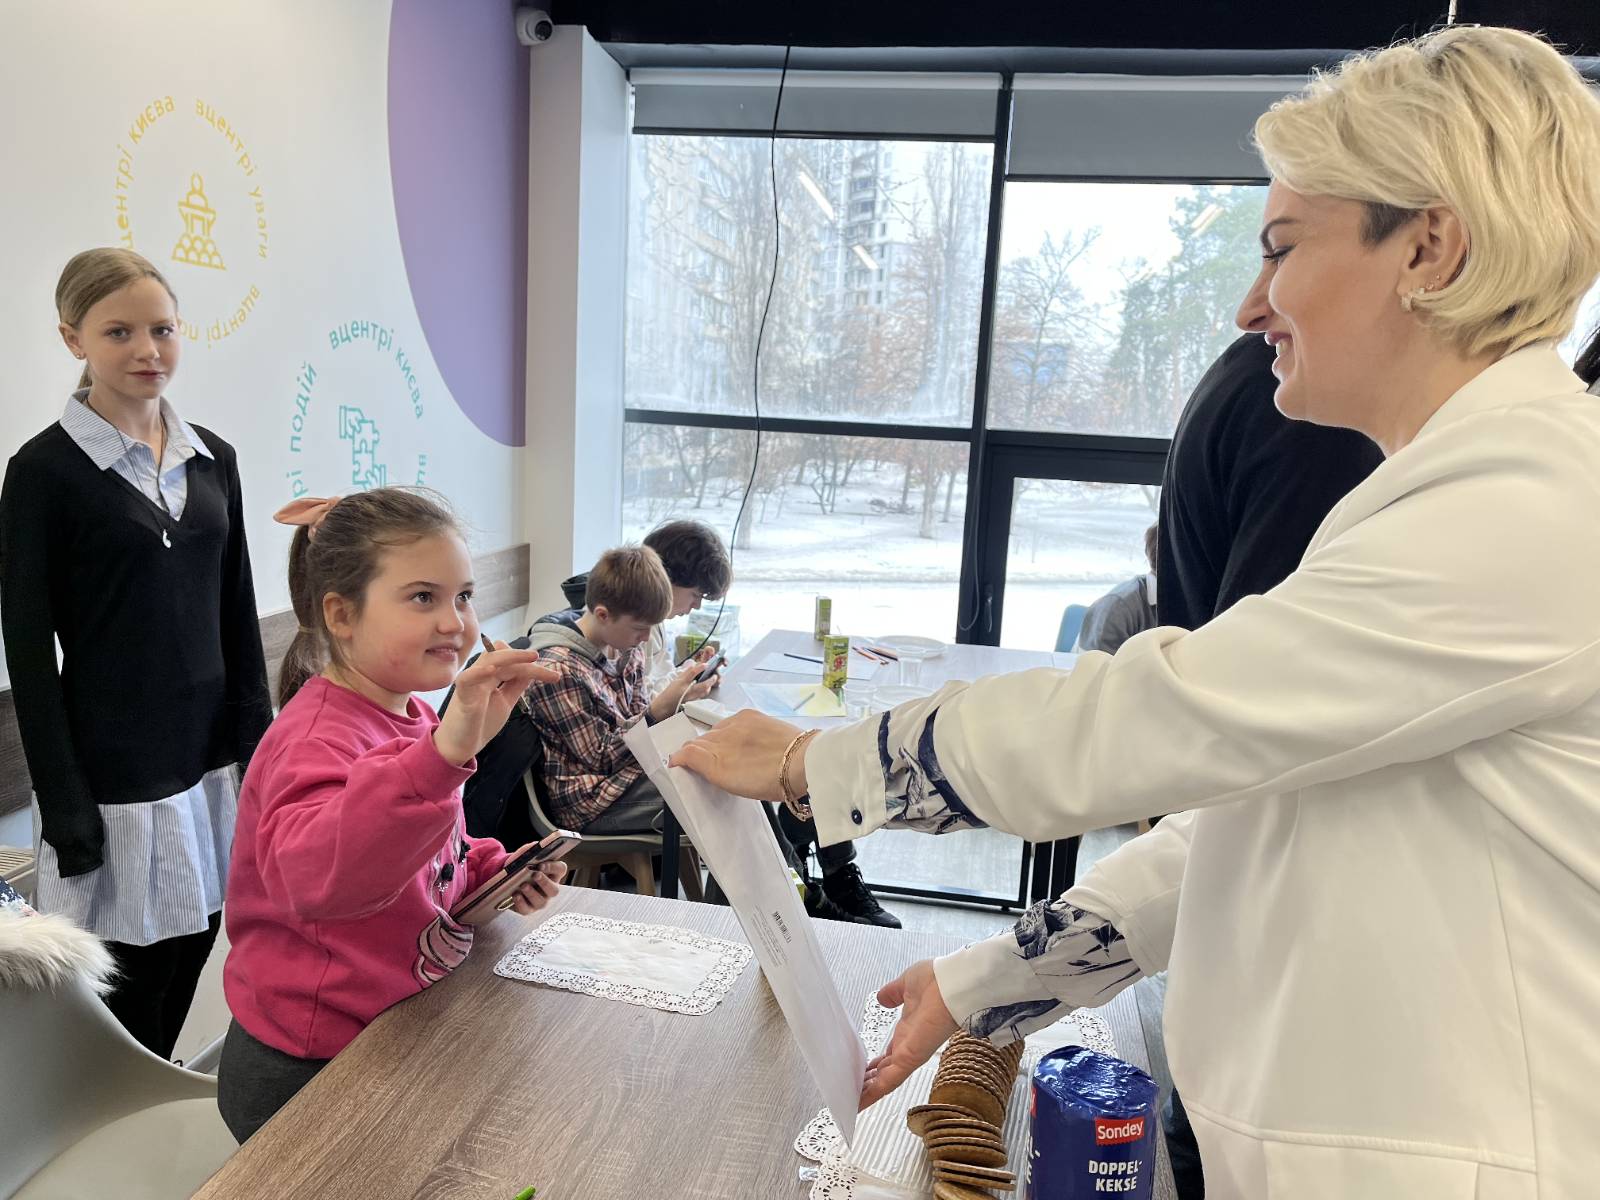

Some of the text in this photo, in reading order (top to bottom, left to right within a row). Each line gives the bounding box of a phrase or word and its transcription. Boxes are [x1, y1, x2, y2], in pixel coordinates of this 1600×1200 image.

[115, 143, 135, 250] центрі
[195, 99, 269, 259] вцентрі уваги
[206, 285, 260, 349] вцентрі
[328, 319, 394, 351] вцентрі
[290, 361, 317, 452] подій
[1097, 1120, 1144, 1140] Sondey
[1088, 1159, 1142, 1175] DOPPEL-
[1095, 1176, 1137, 1192] KEKSE
